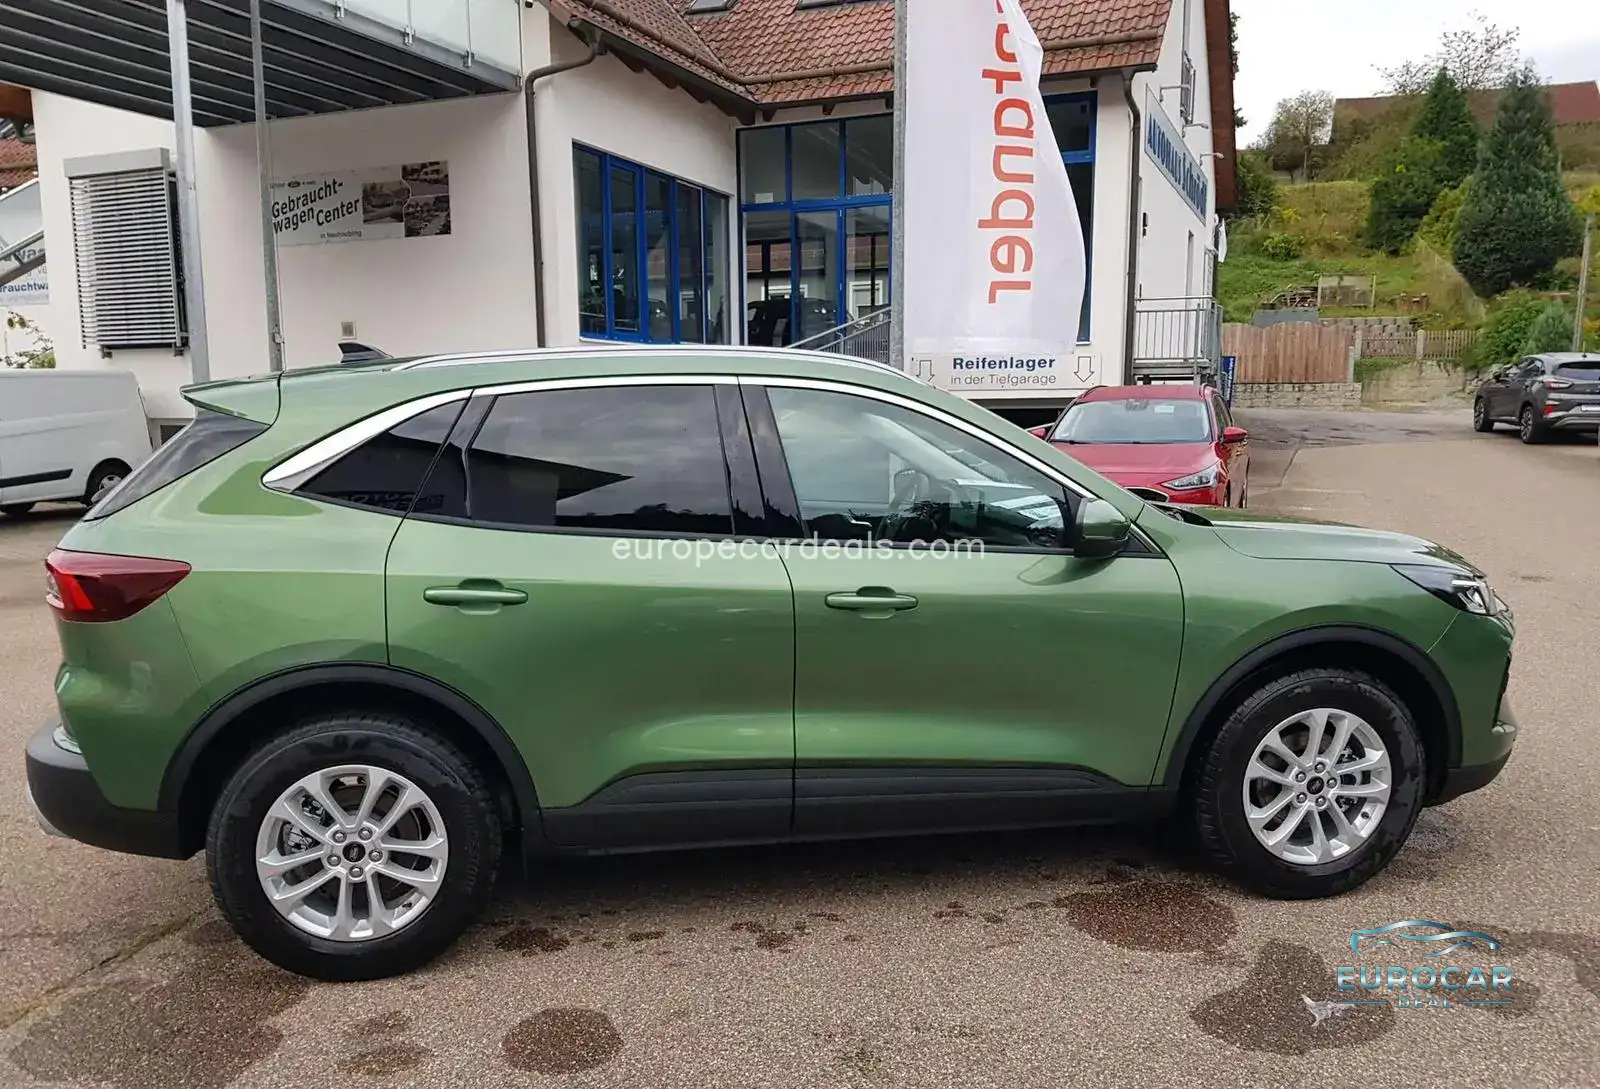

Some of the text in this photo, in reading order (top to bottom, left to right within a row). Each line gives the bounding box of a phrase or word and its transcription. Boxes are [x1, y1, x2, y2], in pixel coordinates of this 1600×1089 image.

[1147, 112, 1182, 187] AUTOHAUS
[271, 178, 343, 219] Gebraucht-
[273, 198, 360, 234] wagen Center
[950, 373, 1057, 387] in der Tiefgarage
[953, 356, 1056, 372] Reifenlager
